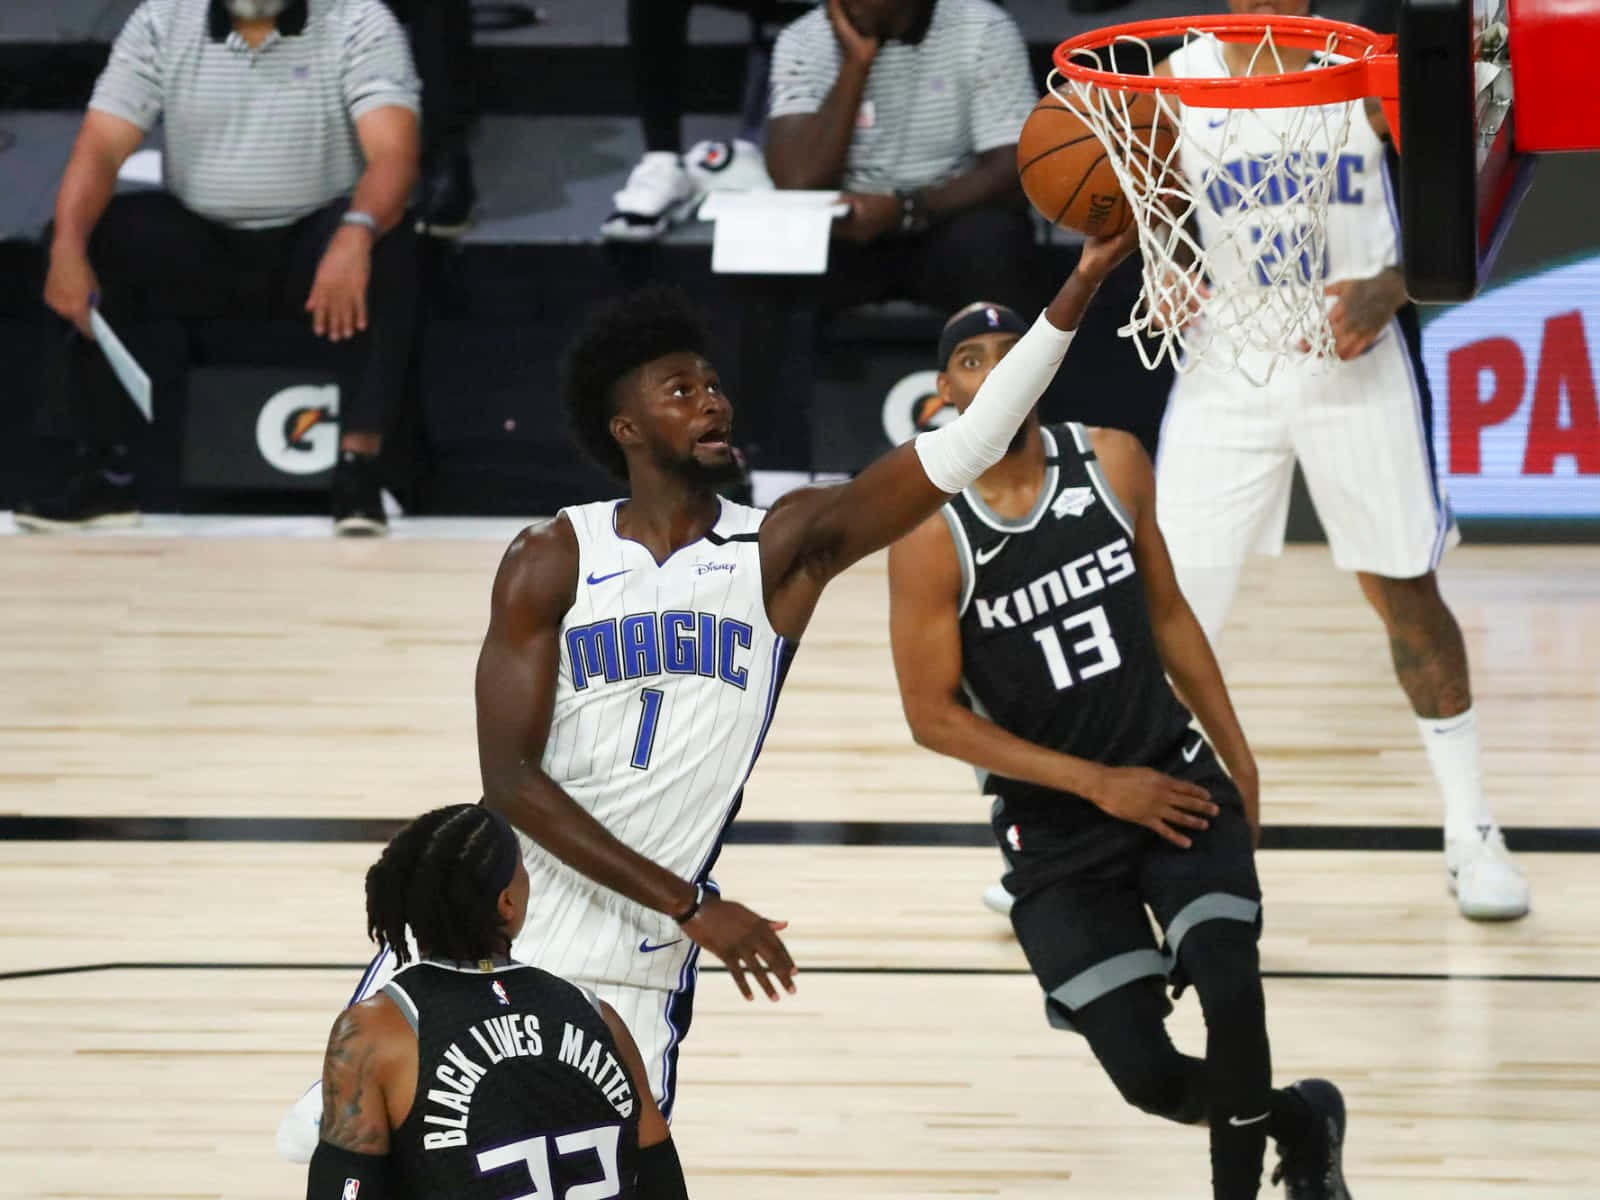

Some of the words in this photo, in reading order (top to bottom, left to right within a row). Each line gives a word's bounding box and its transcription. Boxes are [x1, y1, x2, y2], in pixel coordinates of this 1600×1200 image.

[256, 384, 340, 474] G
[1447, 308, 1600, 474] PA
[691, 561, 737, 576] Disney
[975, 538, 1136, 628] KINGS
[565, 609, 752, 691] MAGIC
[1032, 605, 1121, 690] 13
[630, 687, 664, 770] 1
[423, 1043, 487, 1150] BLACK
[469, 1013, 543, 1065] LIVES
